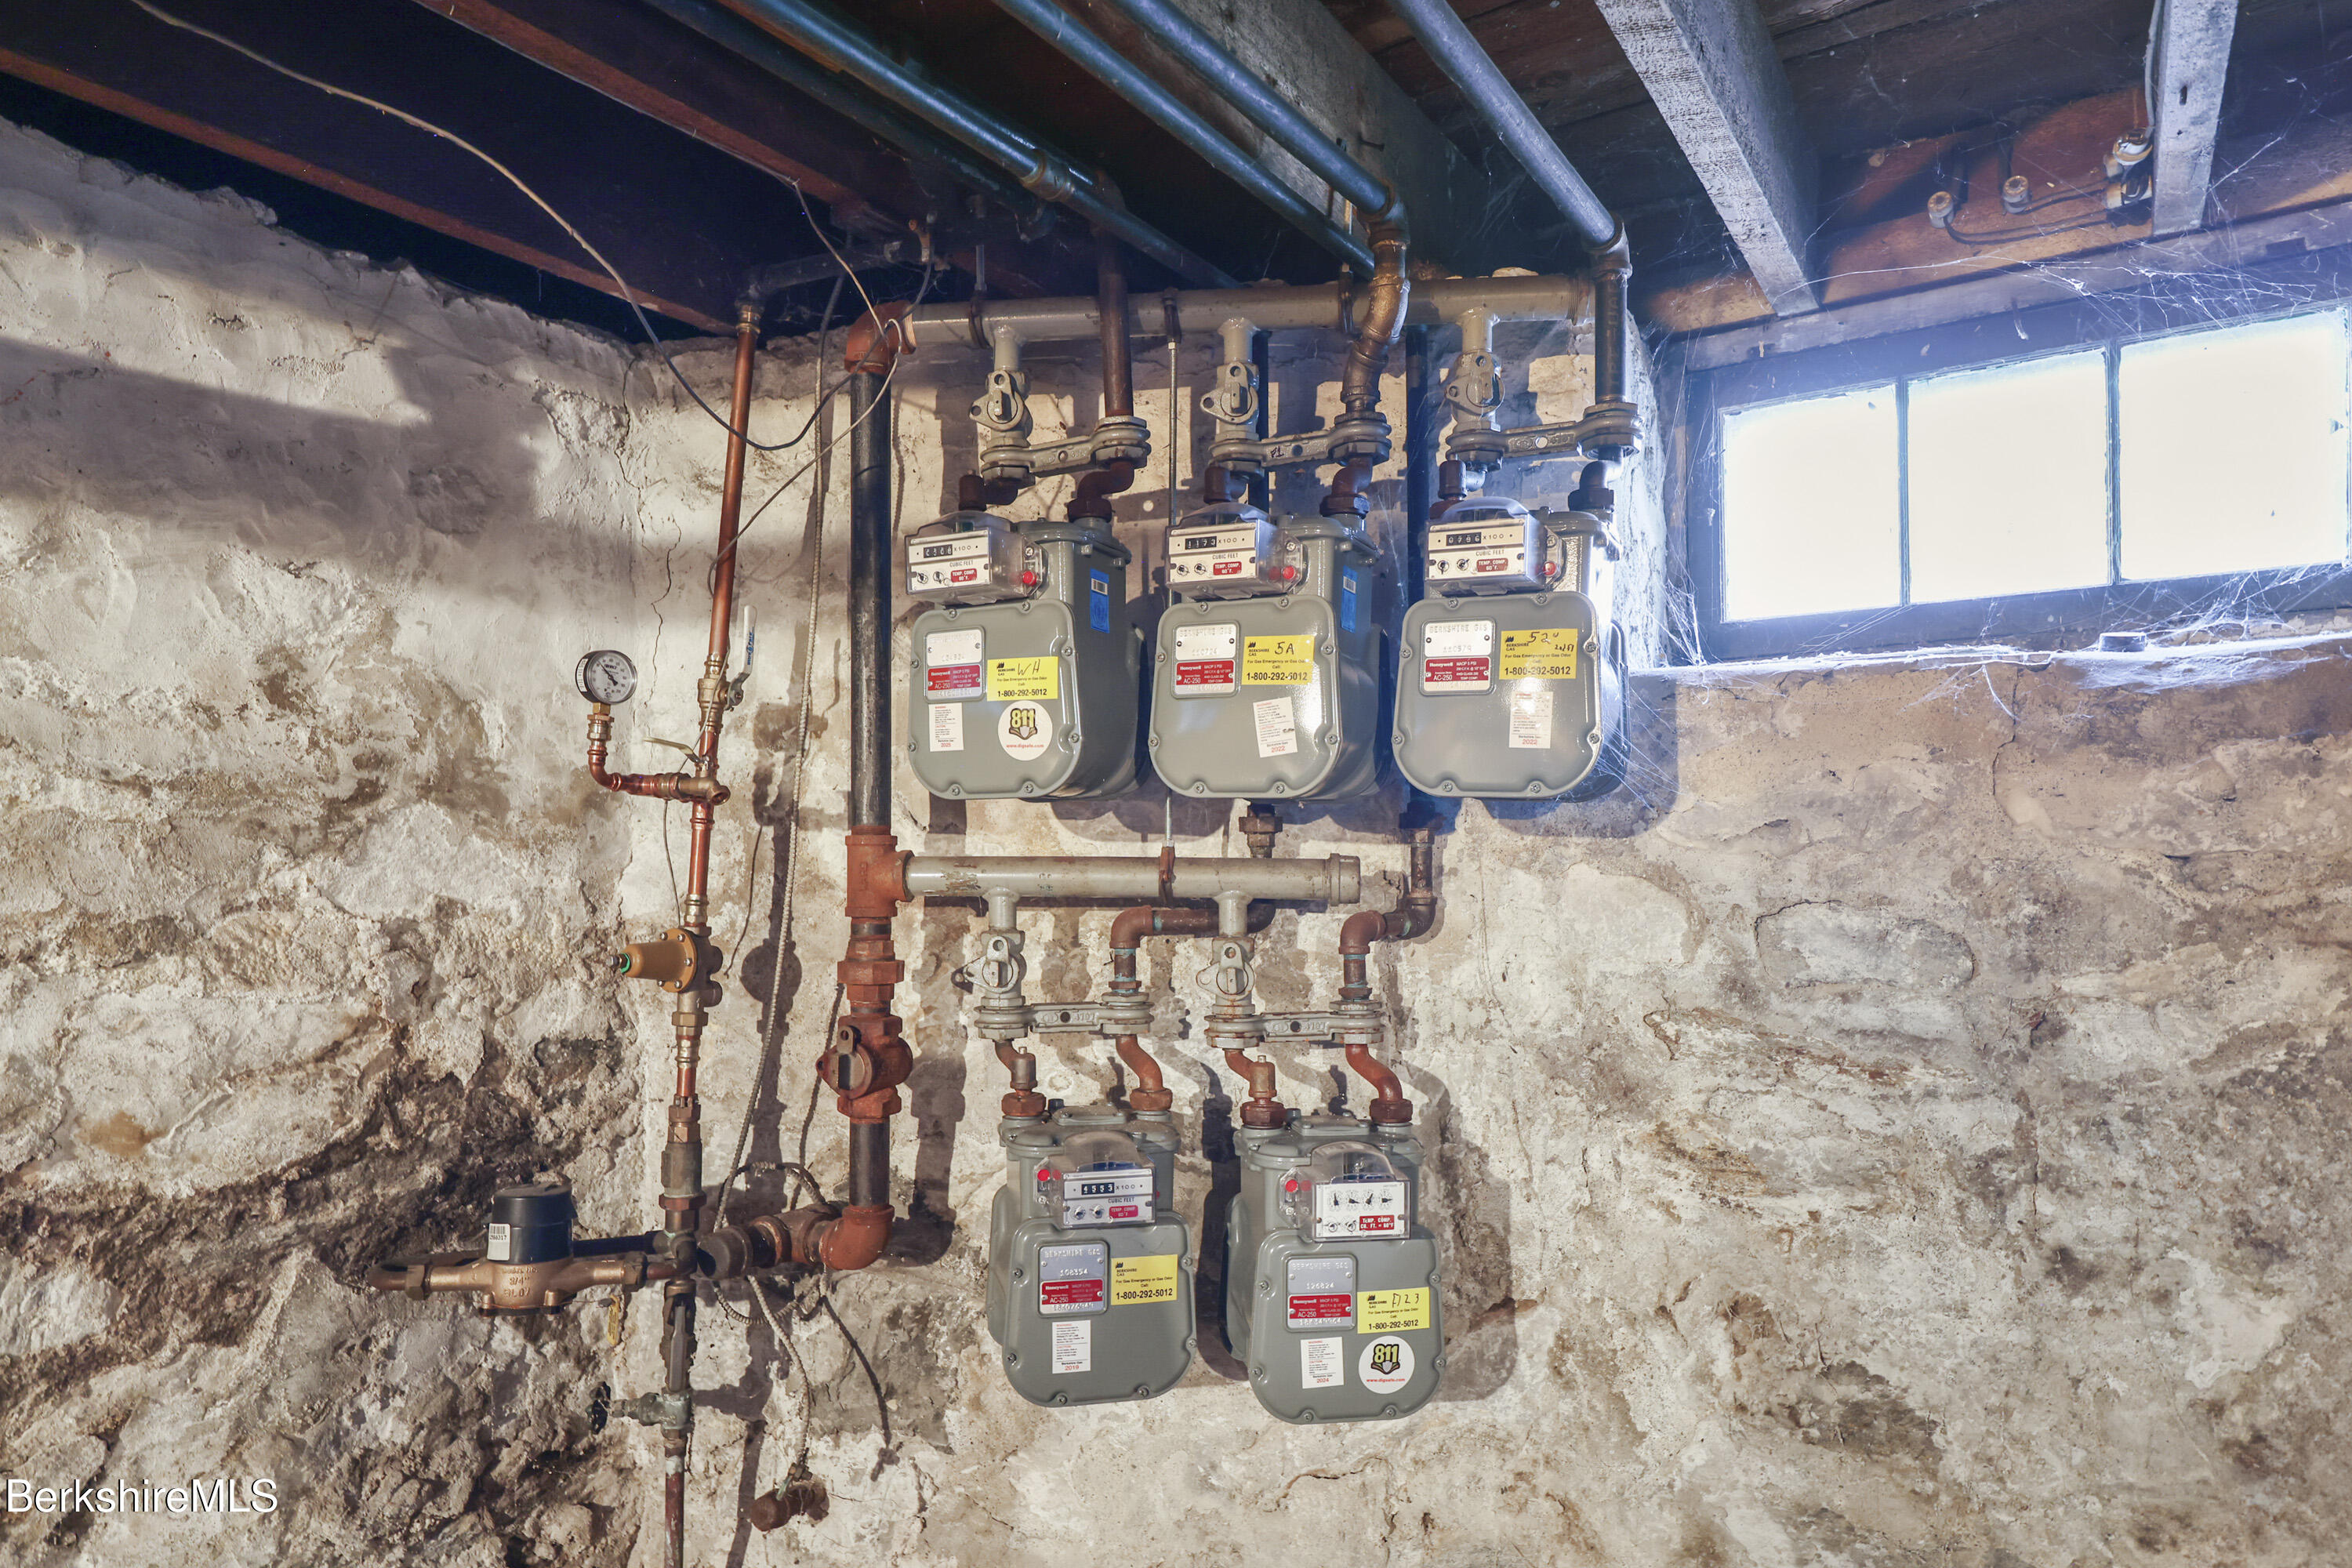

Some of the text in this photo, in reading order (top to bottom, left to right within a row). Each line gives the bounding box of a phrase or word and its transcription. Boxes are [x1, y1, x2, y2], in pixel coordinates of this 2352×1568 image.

[1247, 672, 1307, 681] 1-800-292-5012
[997, 688, 1047, 697] 1-800-292-5012
[1010, 708, 1036, 728] 811
[1116, 1288, 1173, 1300] 1-800-292-5012
[1368, 1319, 1418, 1330] 1-800-292-5012
[1373, 1344, 1399, 1363] 811
